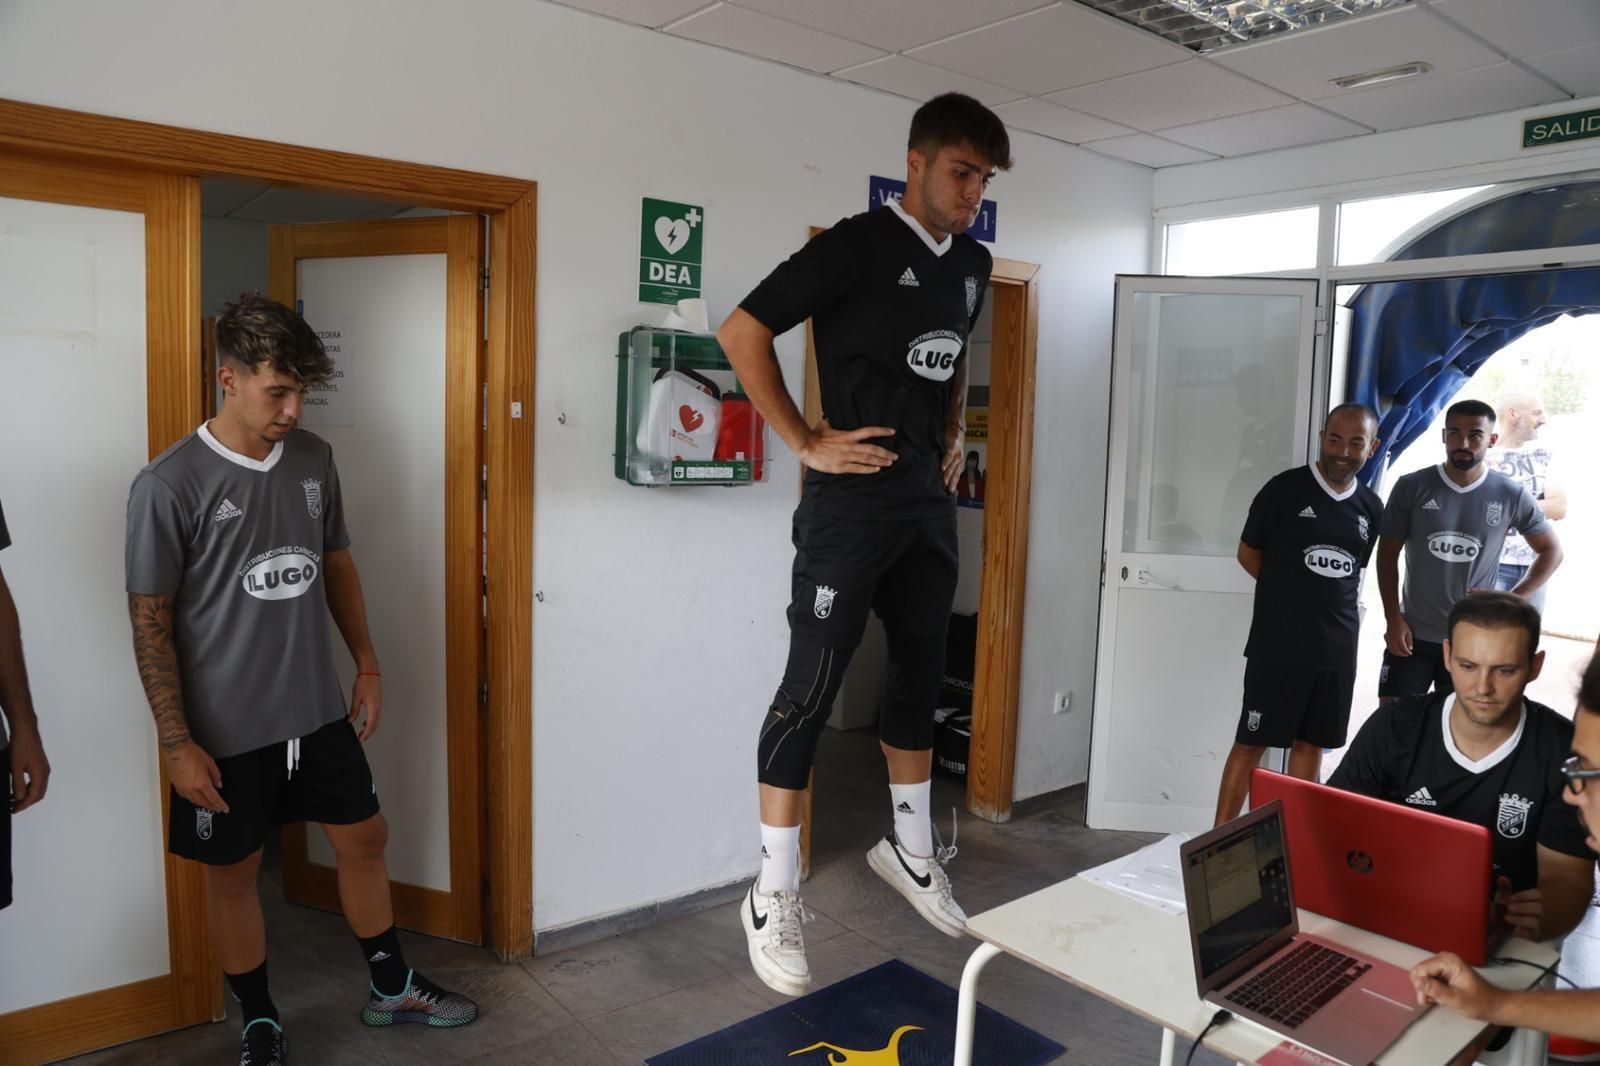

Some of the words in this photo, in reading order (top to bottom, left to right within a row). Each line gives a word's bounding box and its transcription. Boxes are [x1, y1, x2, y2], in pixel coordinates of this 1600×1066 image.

[649, 262, 692, 285] DEA
[911, 348, 954, 370] LUG
[215, 508, 243, 522] adidas
[1431, 540, 1478, 558] LUGO
[1306, 554, 1351, 573] LUGO
[247, 564, 315, 593] LUGO
[1405, 797, 1437, 806] adidas
